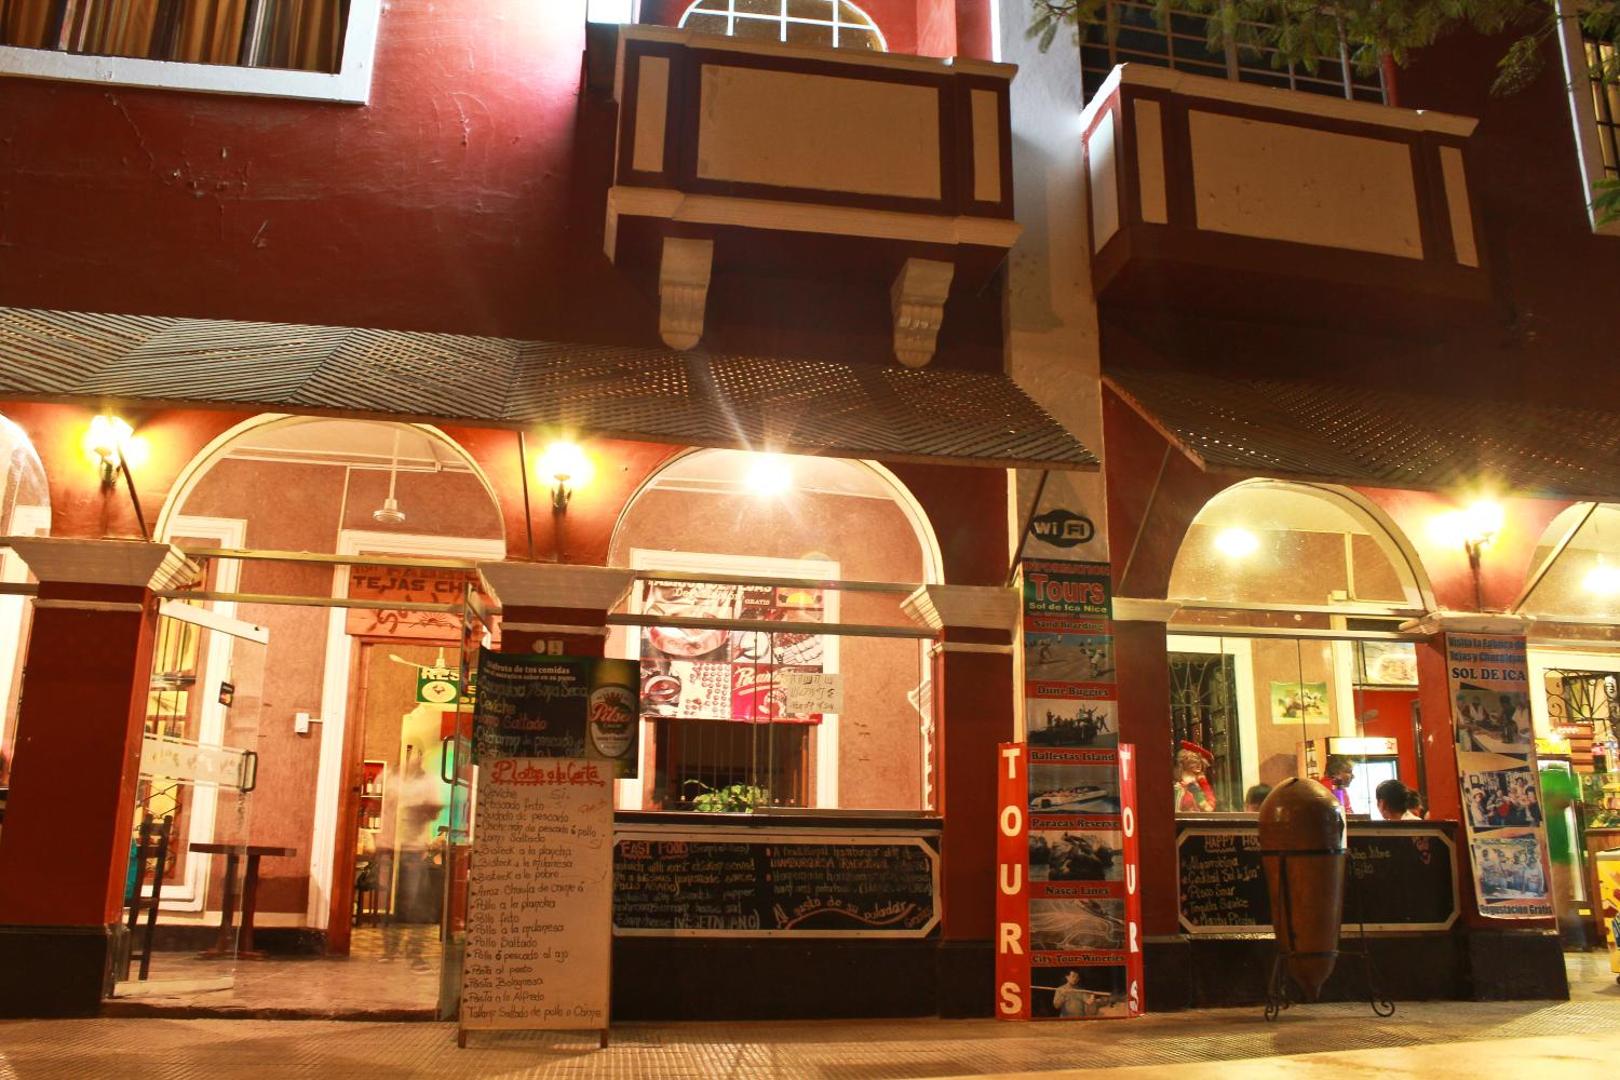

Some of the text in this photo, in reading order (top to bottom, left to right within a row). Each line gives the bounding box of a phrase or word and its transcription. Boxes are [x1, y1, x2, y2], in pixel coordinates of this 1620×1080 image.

[352, 576, 425, 593] TEJAS
[1028, 572, 1105, 605] Tours
[538, 665, 570, 675] comidas
[1452, 667, 1526, 681] SOL DE ICA
[1068, 686, 1109, 697] Buggies
[1032, 751, 1115, 762] Ballestas Island
[491, 760, 545, 781] Platos
[567, 760, 600, 779] Carta
[1204, 835, 1234, 848] HAPPY
[537, 882, 549, 893] de
[1000, 747, 1024, 1015] TOURS
[1119, 751, 1140, 1012] TOURS
[1046, 886, 1109, 896] Nasca Lines
[499, 902, 507, 910] a
[475, 924, 497, 935] Pollo
[473, 936, 538, 948] Pollo Saltado
[503, 949, 539, 962] pescado
[543, 946, 552, 959] al
[513, 990, 545, 1003] Alfredo
[530, 1004, 542, 1017] de
[543, 1004, 563, 1020] pollo
